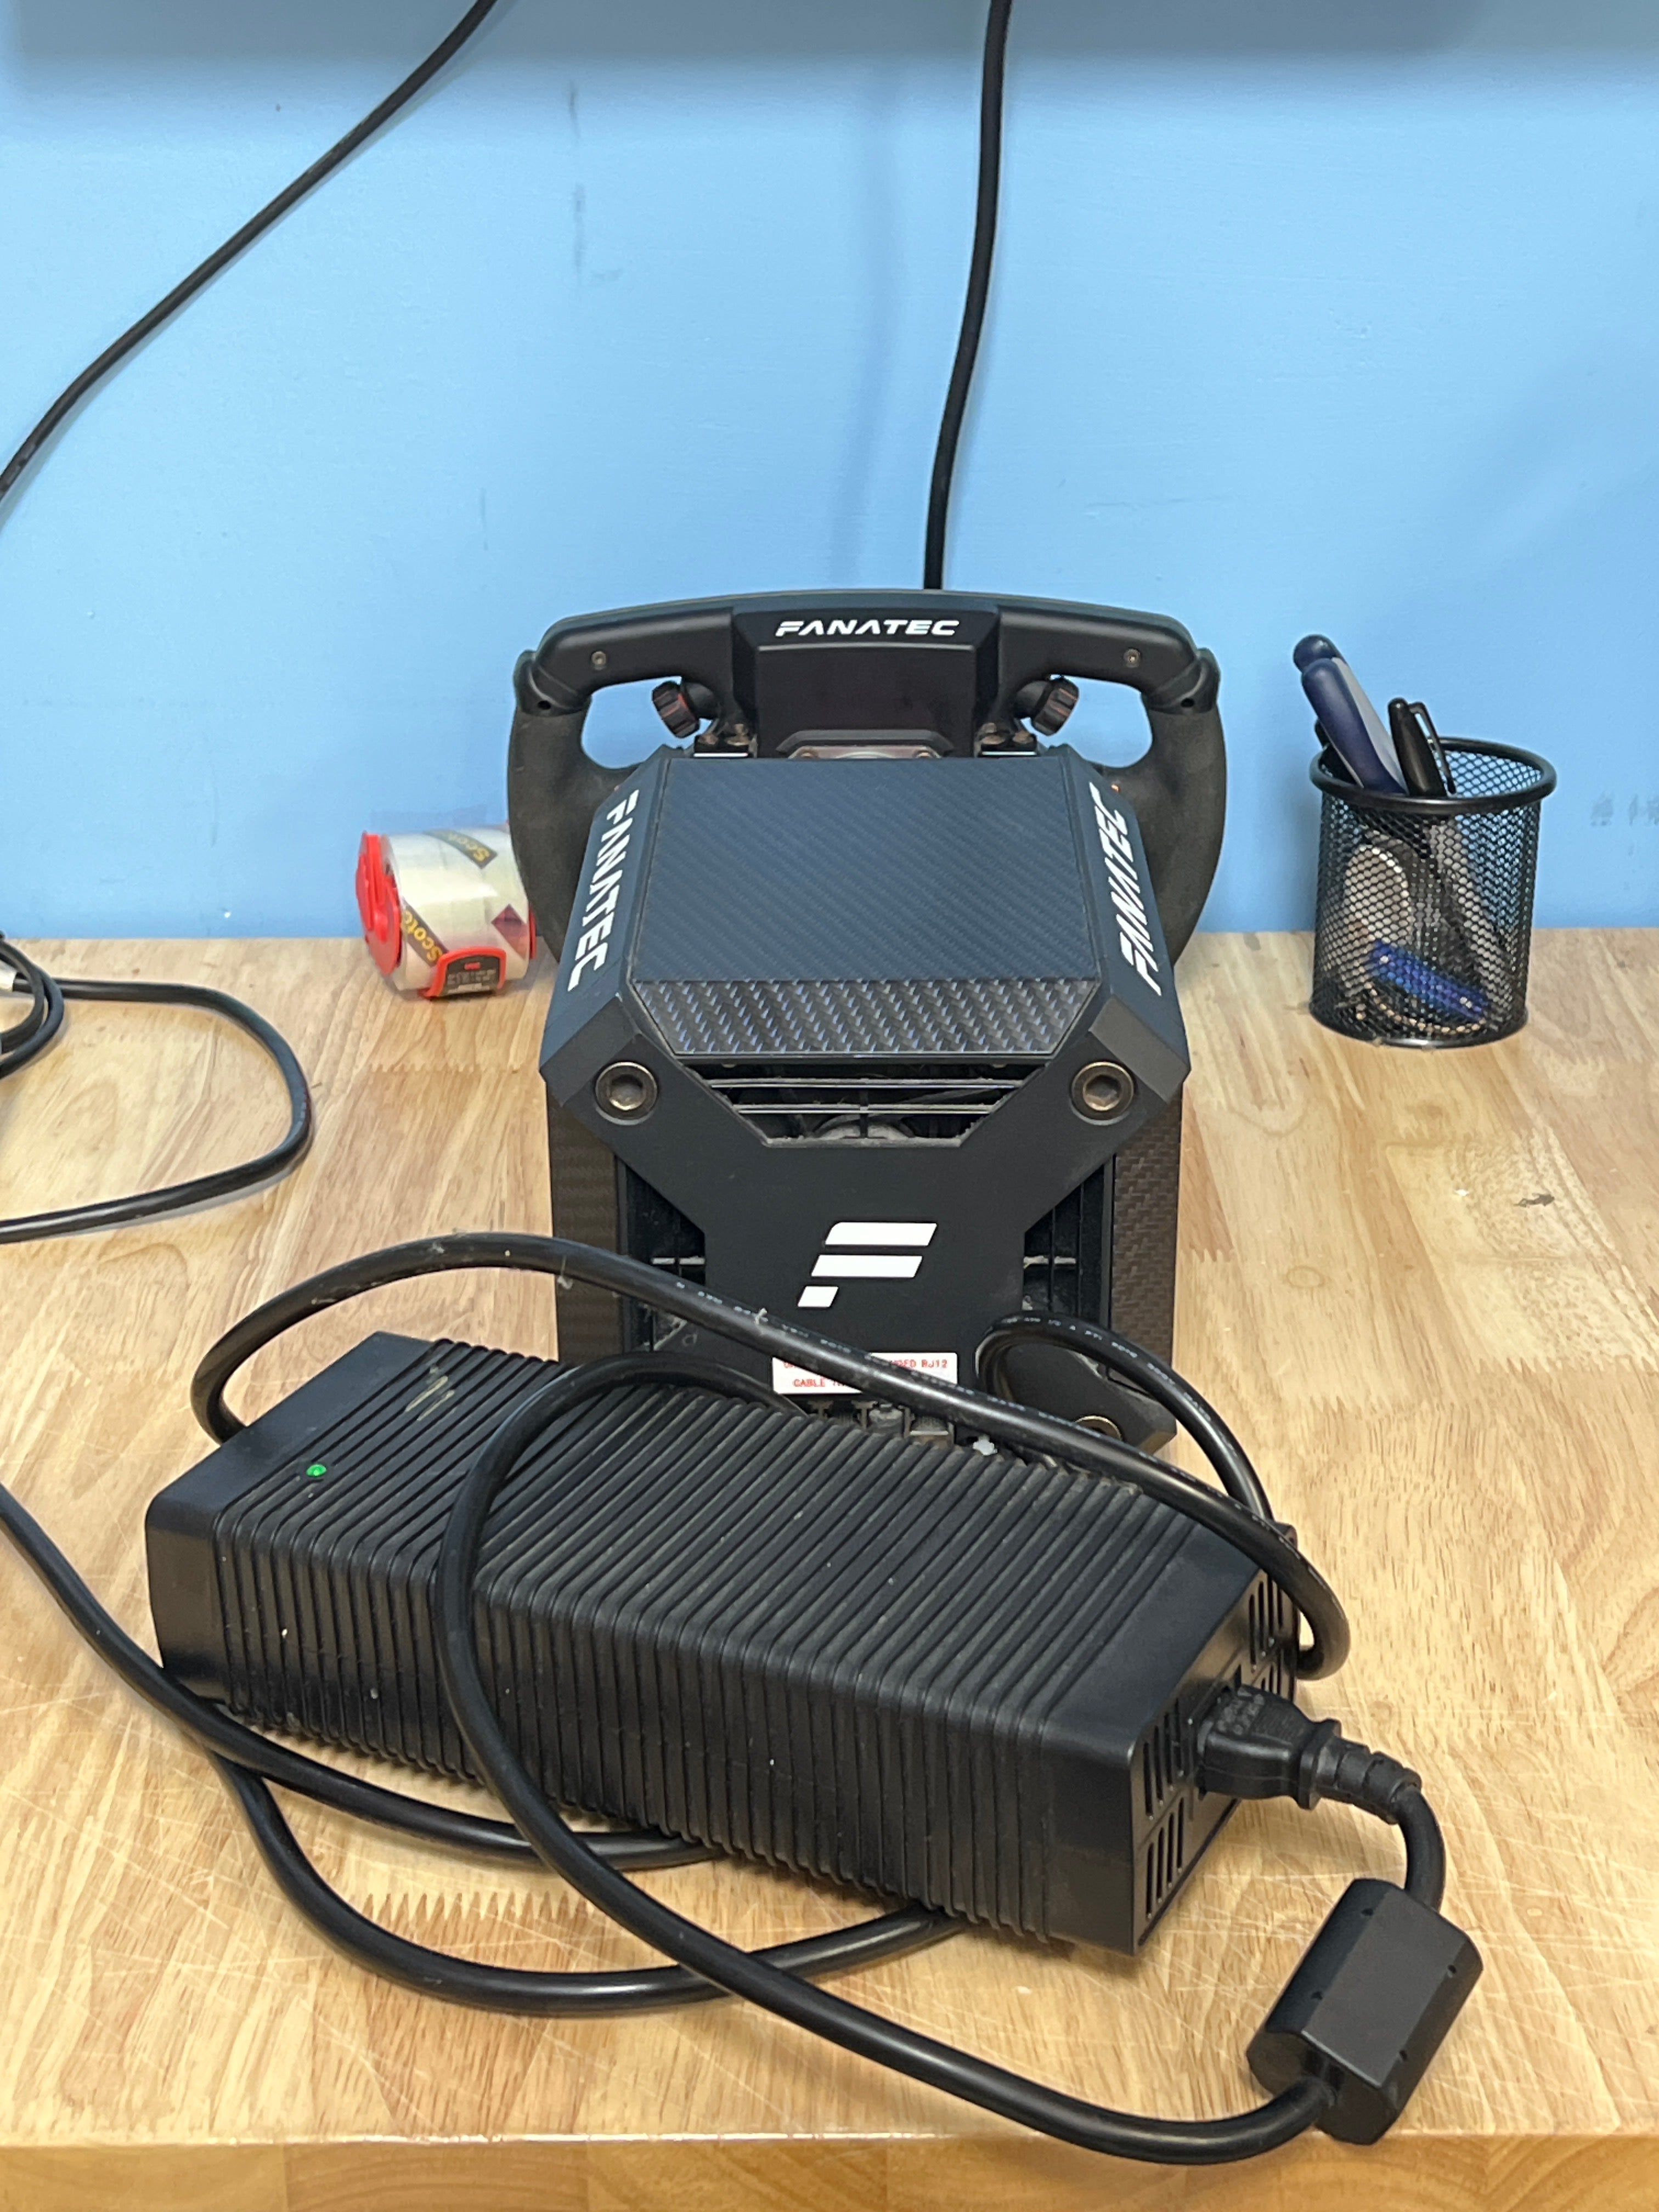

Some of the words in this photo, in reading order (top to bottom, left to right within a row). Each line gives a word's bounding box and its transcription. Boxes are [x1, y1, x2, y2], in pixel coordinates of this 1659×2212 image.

[775, 619, 960, 637] FANATEC
[567, 789, 640, 992] FANATEC
[1089, 782, 1162, 996] FANATEC
[921, 1359, 948, 1368] RJ12
[793, 1378, 825, 1387] CABLE
